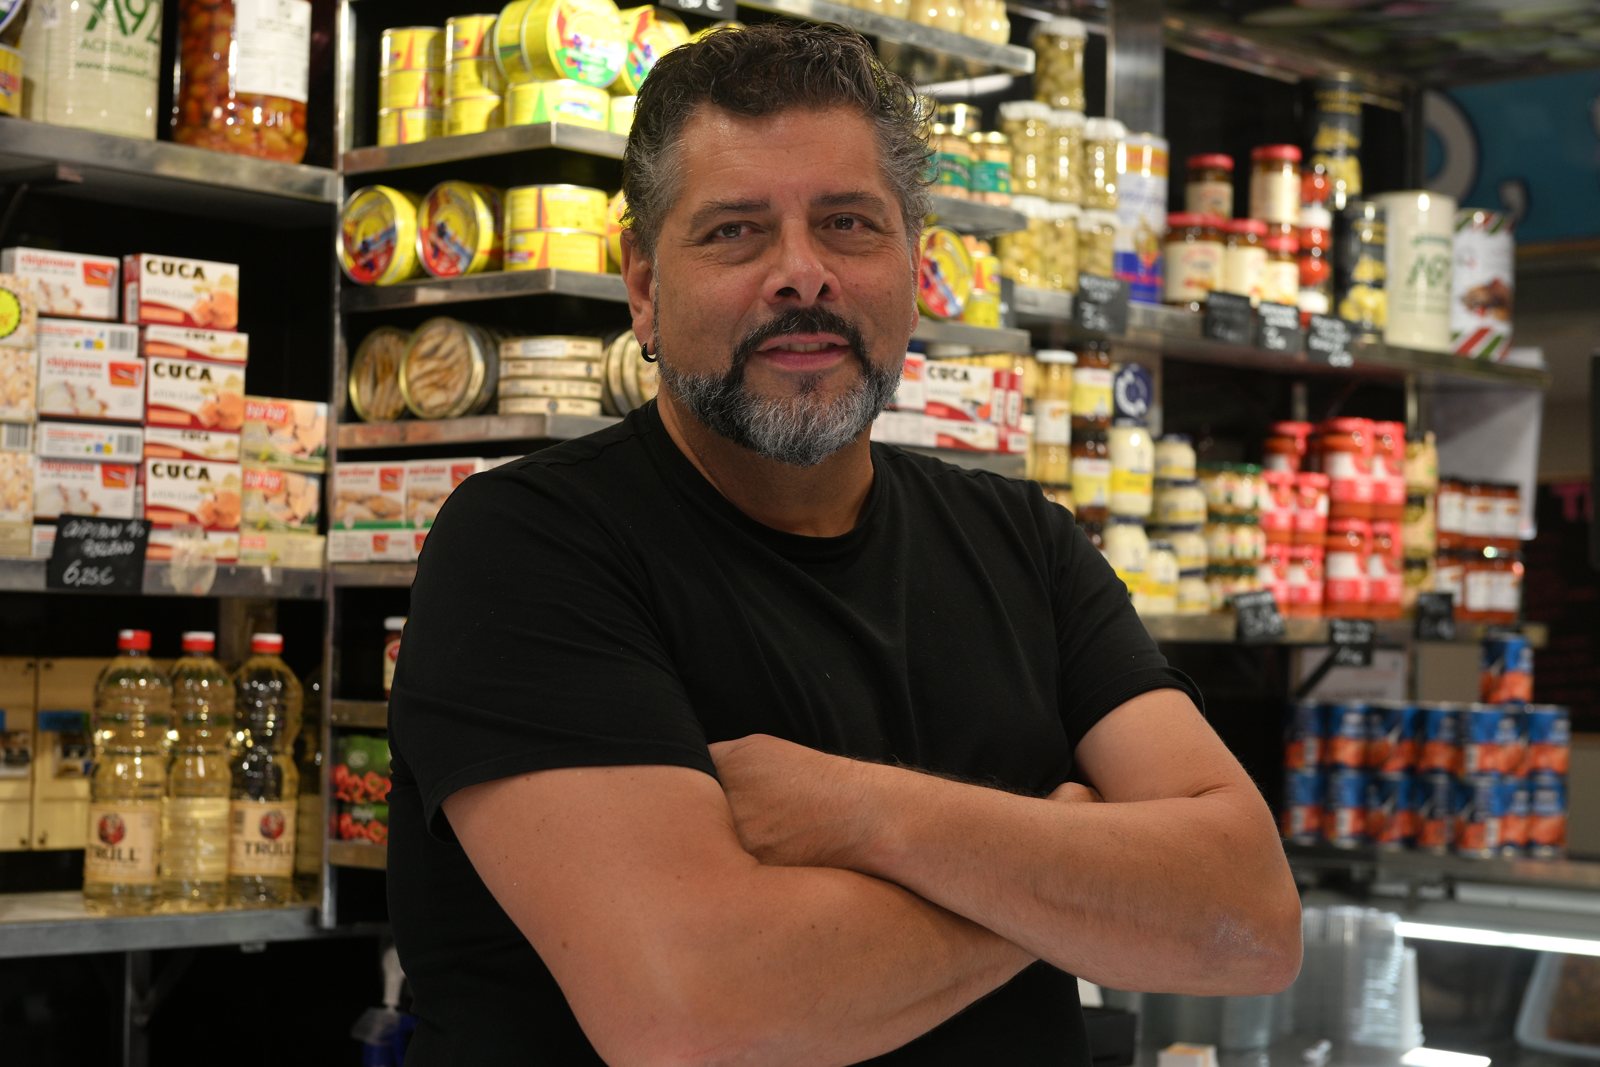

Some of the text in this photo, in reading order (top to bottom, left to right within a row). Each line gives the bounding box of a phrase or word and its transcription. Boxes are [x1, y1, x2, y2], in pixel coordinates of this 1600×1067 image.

[146, 260, 206, 281] CUCA
[153, 363, 212, 382] CUCA
[928, 366, 971, 381] CUCA
[151, 463, 210, 482] CUCA
